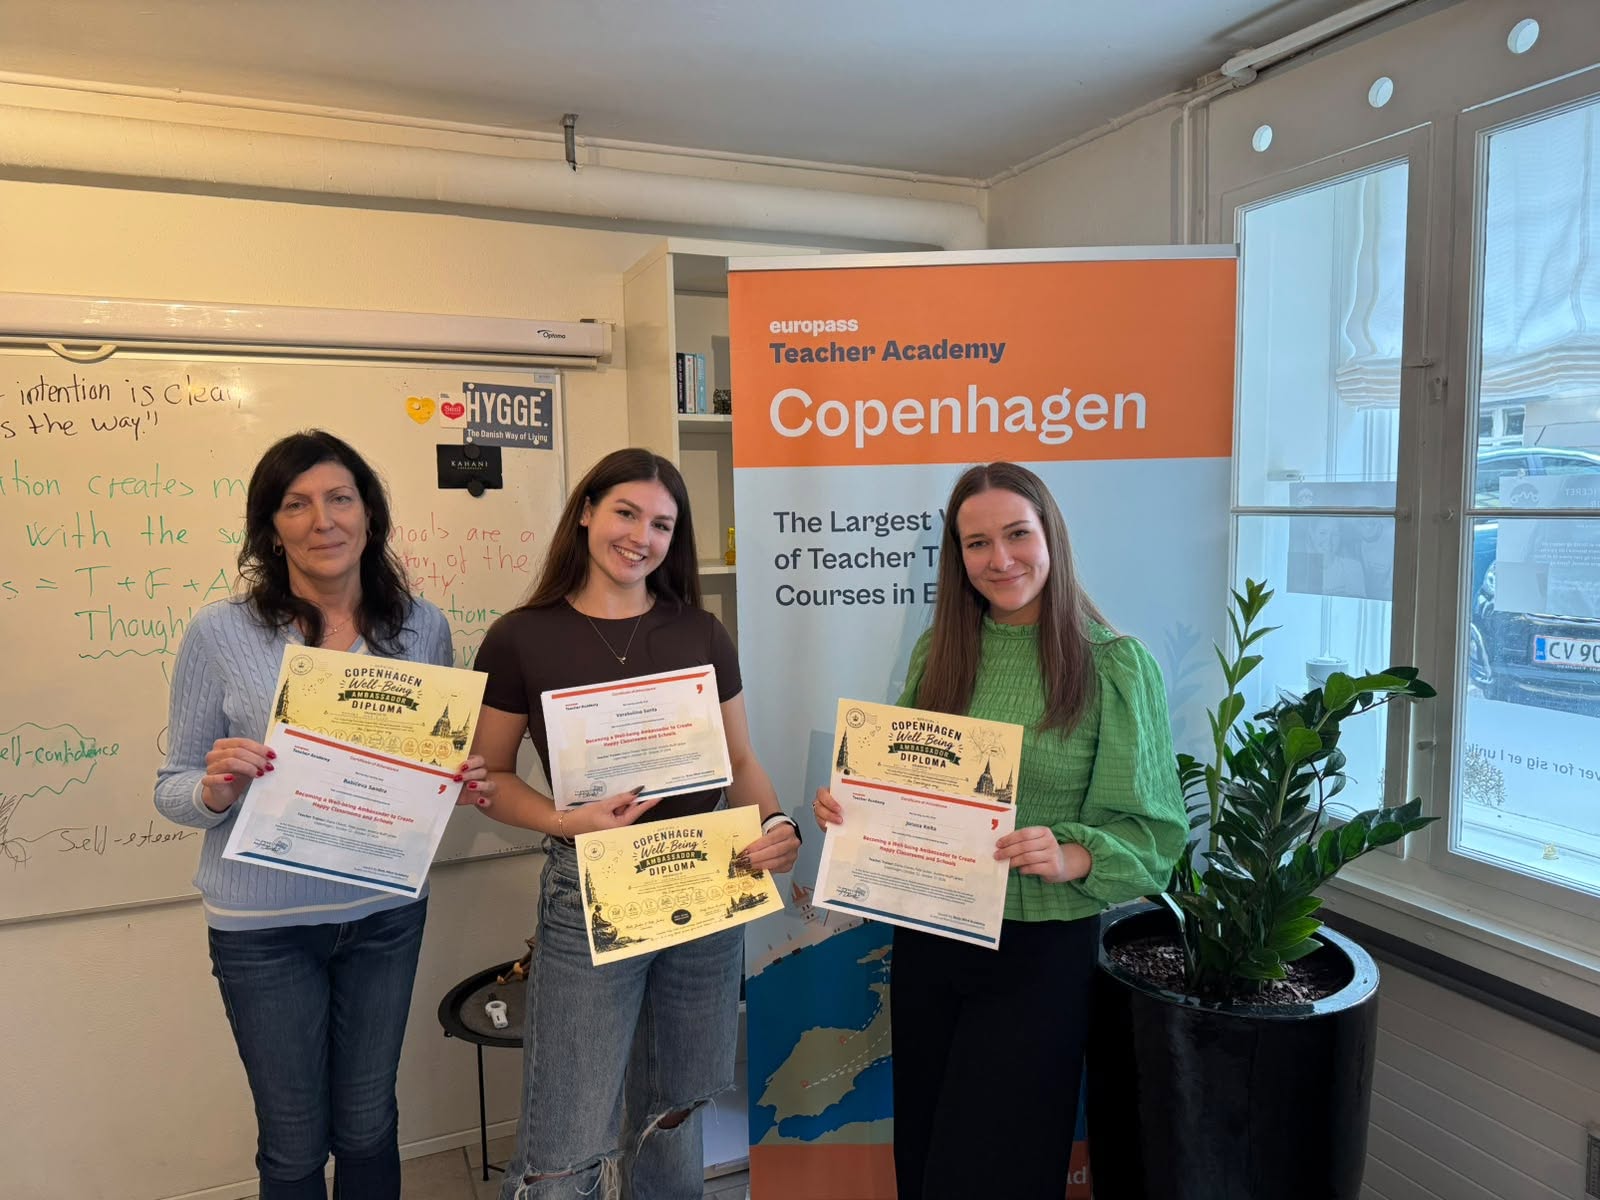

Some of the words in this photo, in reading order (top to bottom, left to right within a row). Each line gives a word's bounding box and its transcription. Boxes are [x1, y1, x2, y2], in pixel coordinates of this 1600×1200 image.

[543, 331, 566, 339] Optoma
[769, 319, 859, 337] europass
[769, 341, 876, 364] Teacher
[881, 339, 1006, 364] Academy
[17, 374, 110, 405] intention
[125, 379, 154, 406] is
[28, 412, 78, 437] the
[769, 384, 1147, 448] Copenhagen
[468, 429, 480, 437] The
[481, 430, 504, 439] Danish
[505, 432, 518, 440] Way
[520, 432, 527, 440] of
[528, 433, 548, 443] Living
[88, 462, 194, 498] creates
[26, 511, 111, 548] with
[140, 515, 188, 546] the
[773, 511, 823, 534] The
[830, 508, 932, 537] Largest
[483, 545, 529, 573] the
[774, 549, 802, 570] of
[807, 546, 916, 570] Teacher
[775, 584, 885, 607] Courses
[893, 583, 915, 605] in
[1549, 642, 1575, 660] CV
[345, 668, 422, 687] COPENHAGEN
[349, 678, 413, 696] Well-Being
[352, 691, 407, 704] AMBASSADOR
[352, 700, 402, 714] DIPLOMA
[603, 740, 619, 748] Happy
[658, 731, 676, 739] Schools
[892, 721, 962, 741] COPENHAGEN
[896, 731, 953, 751] Well-Being
[900, 744, 950, 758] AMBASSADOR
[901, 753, 946, 768] DIPLOMA
[295, 790, 322, 801] Becoming
[328, 798, 356, 810] Well-being
[358, 806, 390, 817] Ambassador
[397, 815, 414, 823] Create
[312, 802, 330, 811] Happy
[331, 806, 361, 818] Classrooms
[374, 816, 394, 825] Schools
[633, 829, 703, 849] COPENHAGEN
[641, 839, 698, 858] Well-Being
[863, 835, 886, 845] Becoming
[920, 847, 951, 858] Ambassador
[958, 855, 976, 863] Create
[646, 851, 696, 866] AMBASSADOR
[880, 846, 895, 854] Happy
[896, 849, 925, 860] Classrooms
[936, 857, 956, 867] Schools
[649, 861, 696, 876] DIPLOMA
